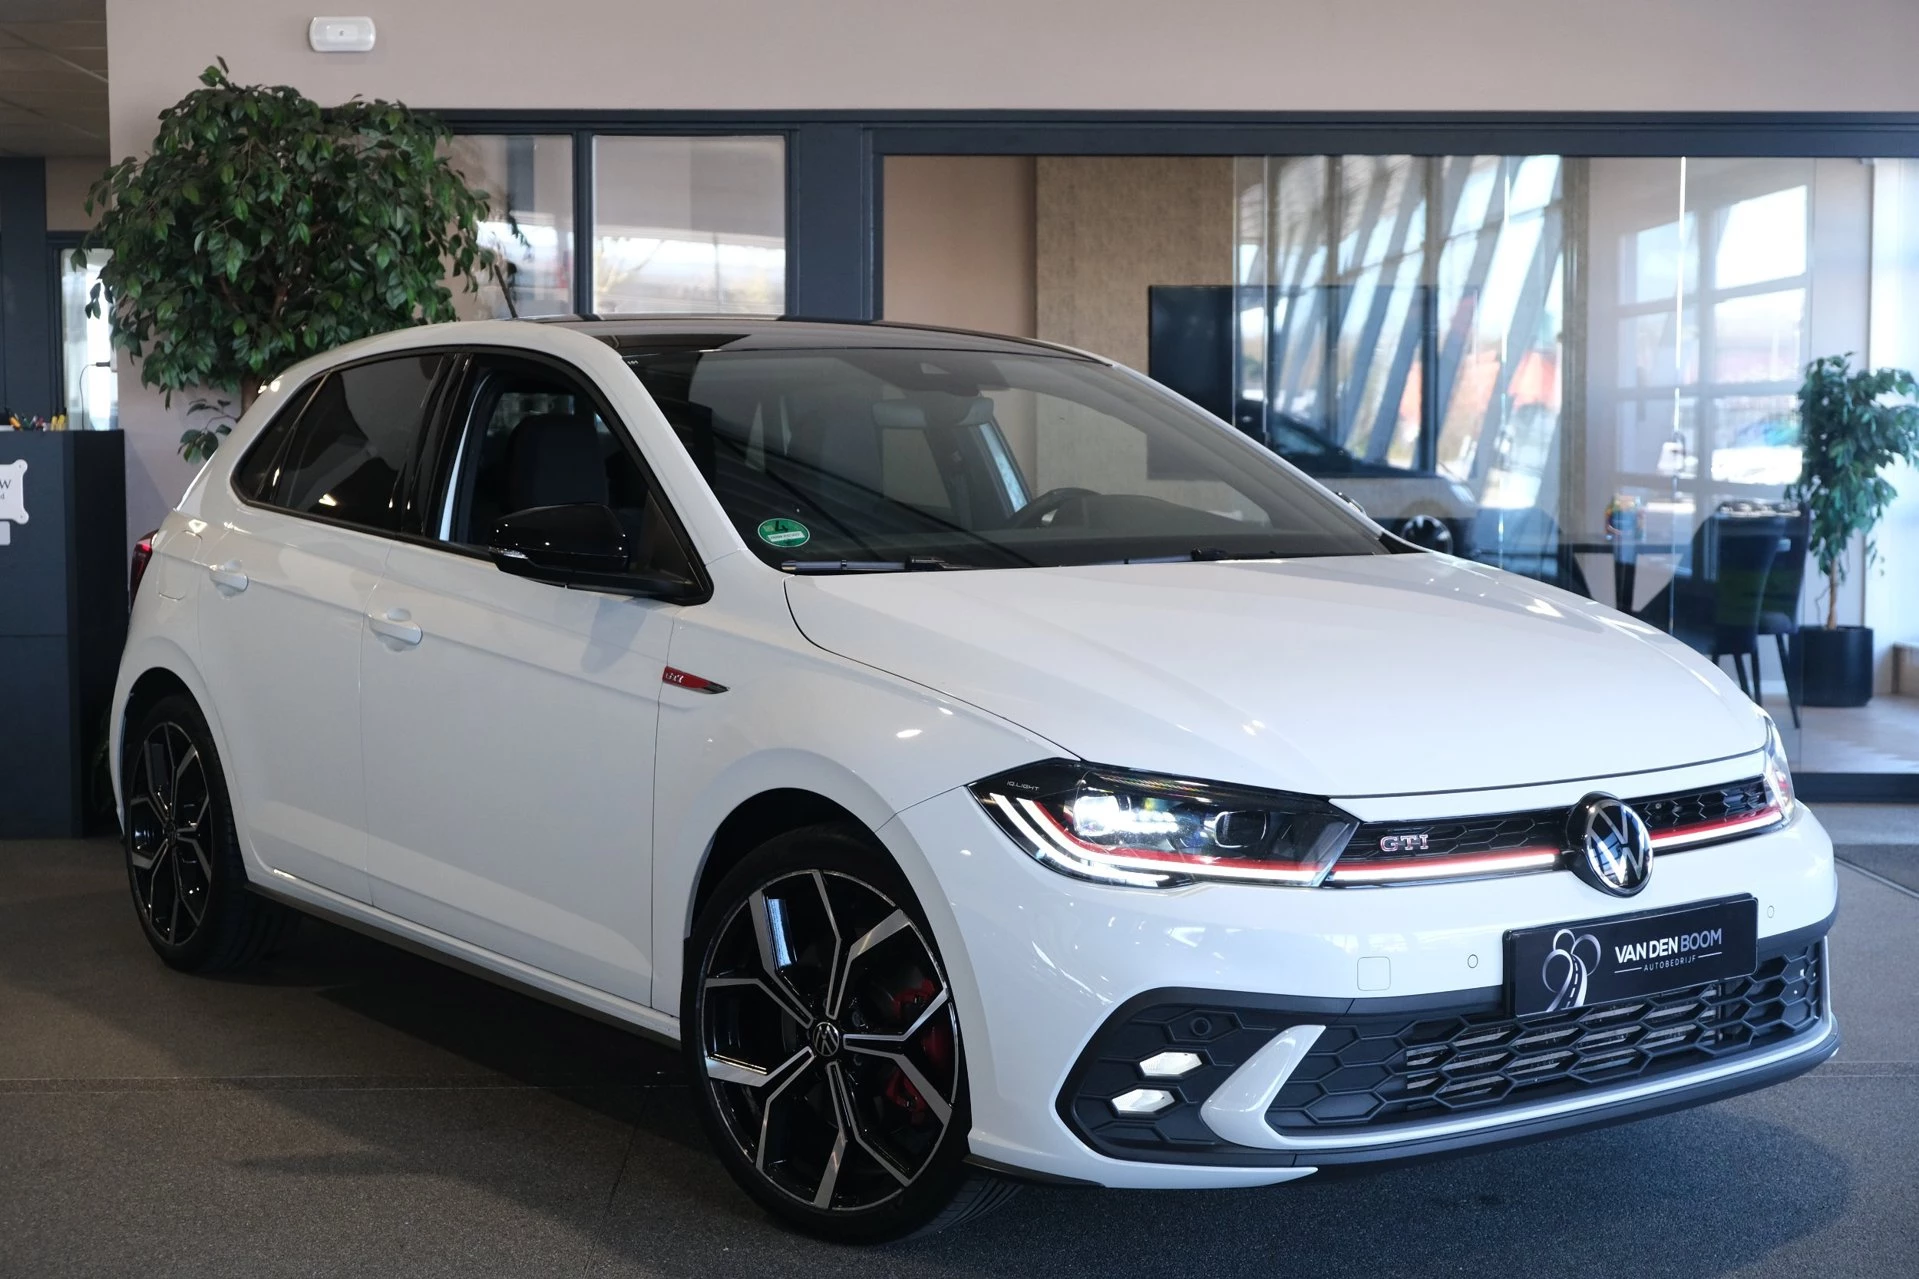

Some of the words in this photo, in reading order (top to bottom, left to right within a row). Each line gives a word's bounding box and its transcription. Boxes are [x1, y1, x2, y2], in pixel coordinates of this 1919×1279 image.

[1380, 834, 1429, 852] GTI
[1615, 942, 1647, 964] VAN
[1649, 936, 1679, 957] DEN
[1680, 928, 1722, 952] BOOM
[1643, 956, 1696, 972] AUTOBEDRIJF
